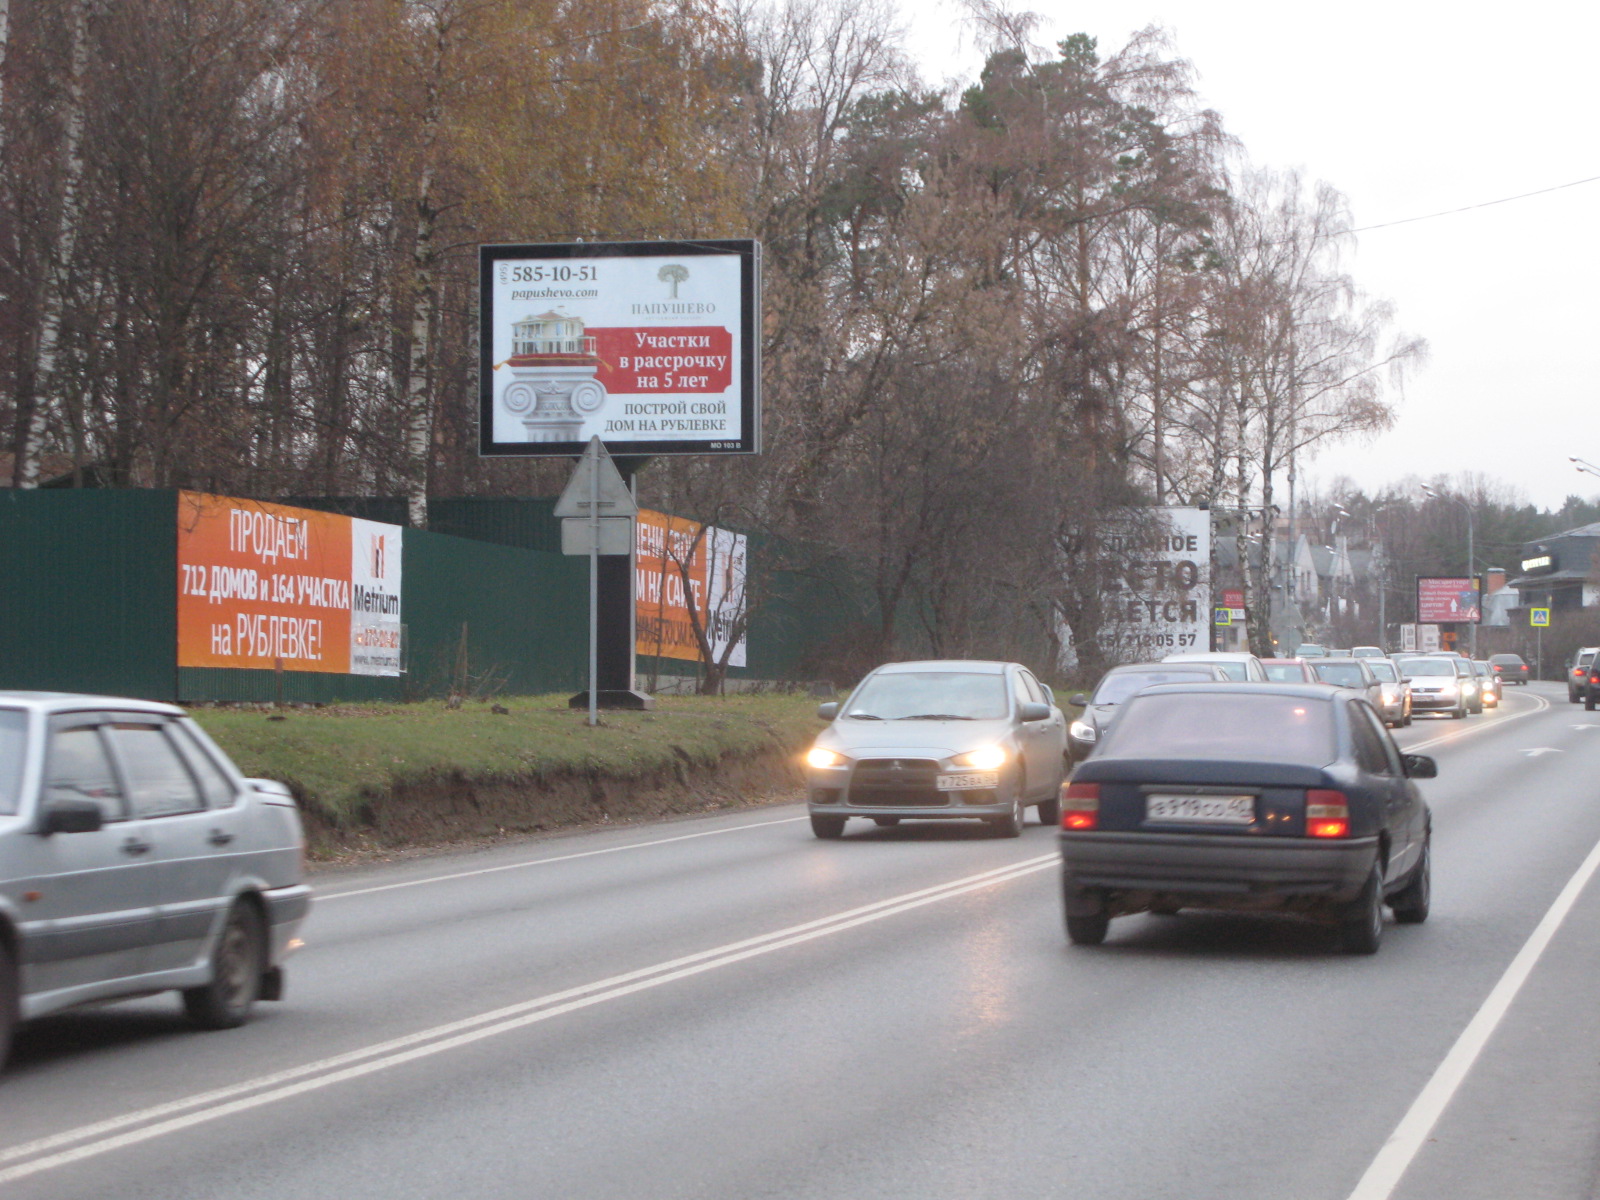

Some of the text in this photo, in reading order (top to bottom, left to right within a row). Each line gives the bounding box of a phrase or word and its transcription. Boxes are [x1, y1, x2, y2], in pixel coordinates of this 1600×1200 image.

[512, 265, 597, 282] 585-10-51
[512, 286, 598, 300] papushevo.com
[632, 303, 716, 315] ПАПУШЕВО
[635, 332, 710, 348] Участки
[619, 355, 727, 371] в рассрочку
[637, 372, 708, 388] на 5 лет
[624, 400, 726, 415] ПОСТРОЙ СВОЙ
[604, 419, 727, 433] ДОМ НА РУБЛЕВКЕ
[230, 508, 308, 566] ПРОДАЕМ
[1100, 560, 1199, 591] ЕСТО
[182, 564, 350, 610] 712 ДОМОВ и 164 УЧАСТКА
[354, 584, 399, 616] Metrium
[211, 623, 232, 656] на
[236, 612, 322, 661] РУБЛЕВКЕ!
[1156, 633, 1174, 647] 05
[1179, 633, 1197, 647] 57
